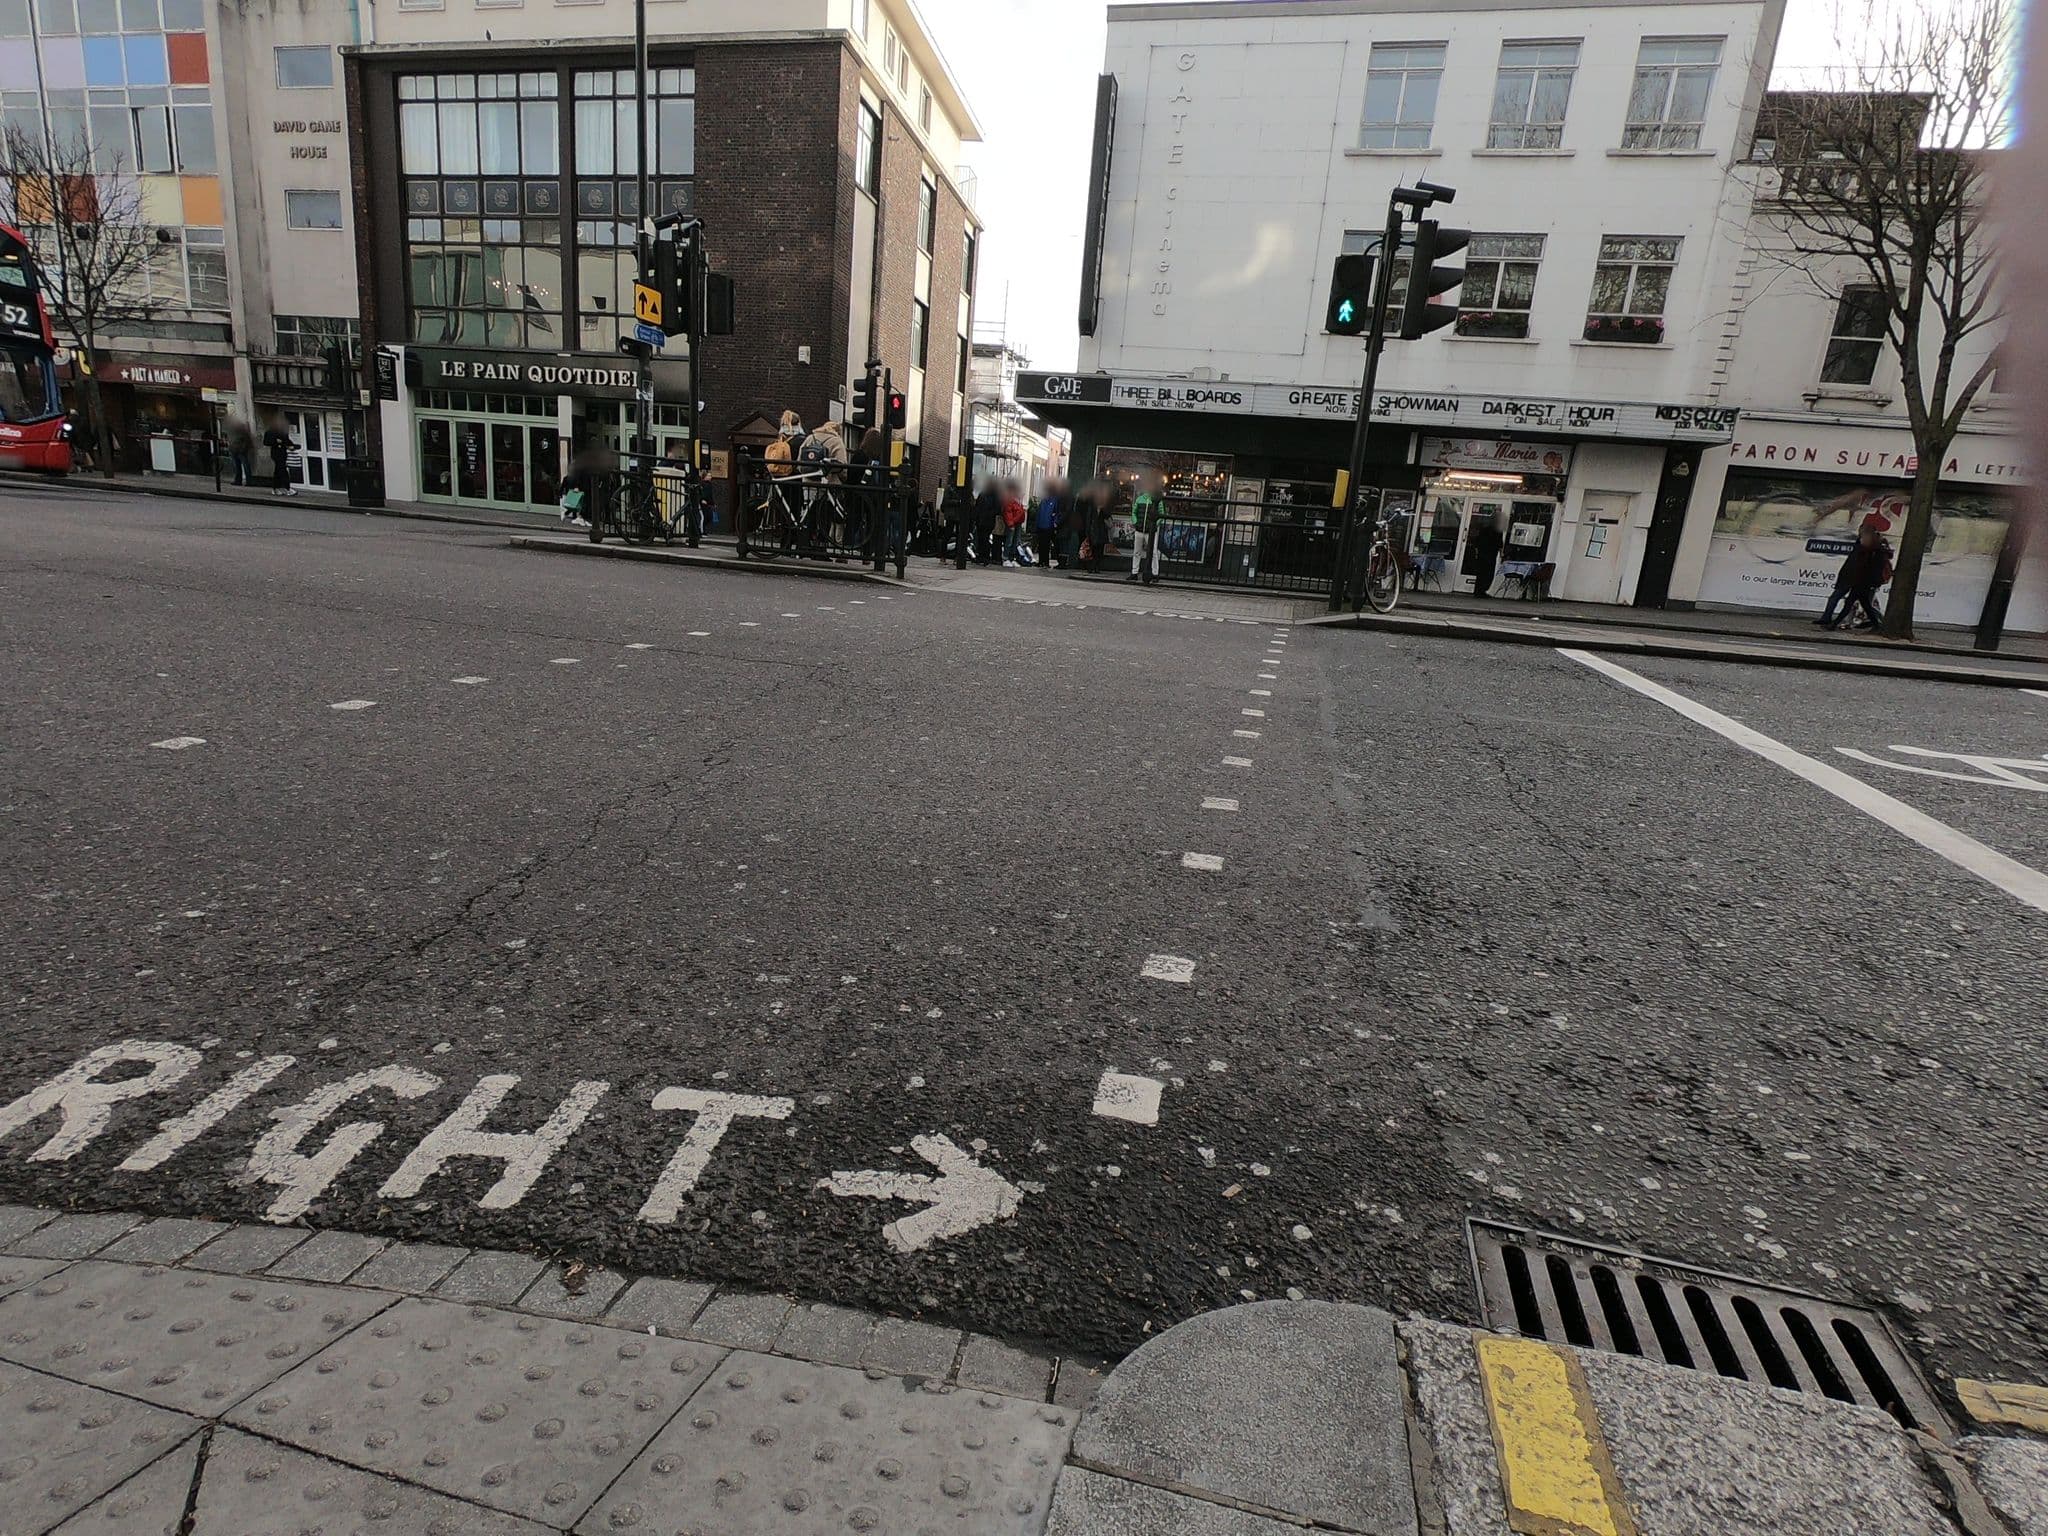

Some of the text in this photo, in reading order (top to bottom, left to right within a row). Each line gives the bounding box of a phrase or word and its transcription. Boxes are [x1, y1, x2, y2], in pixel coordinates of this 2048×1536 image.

[1167, 53, 1196, 164] GATE
[273, 120, 341, 133] DAVID GAME
[290, 145, 328, 159] HOUSE
[4, 304, 29, 326] 52
[441, 360, 466, 377] LE
[472, 362, 520, 380] PAIN
[1044, 376, 1082, 395] GATE
[1114, 386, 1242, 405] THREE BILLBOARDS
[1135, 399, 1195, 409] ON SALE NOW
[1378, 396, 1459, 412] SHOWMAN
[1325, 406, 1347, 414] NOW
[1482, 401, 1615, 421] DARKEST HOUR
[1514, 416, 1591, 428] ON SALE NOW
[1493, 441, 1539, 460] Maria
[1730, 443, 1818, 463] FARON
[1836, 451, 1958, 474] SUTAA
[1752, 575, 1768, 583] our
[1770, 576, 1796, 586] larger
[1798, 580, 1828, 588] branch
[1799, 568, 1836, 581] We've
[0, 1039, 797, 1226] RIGHT
